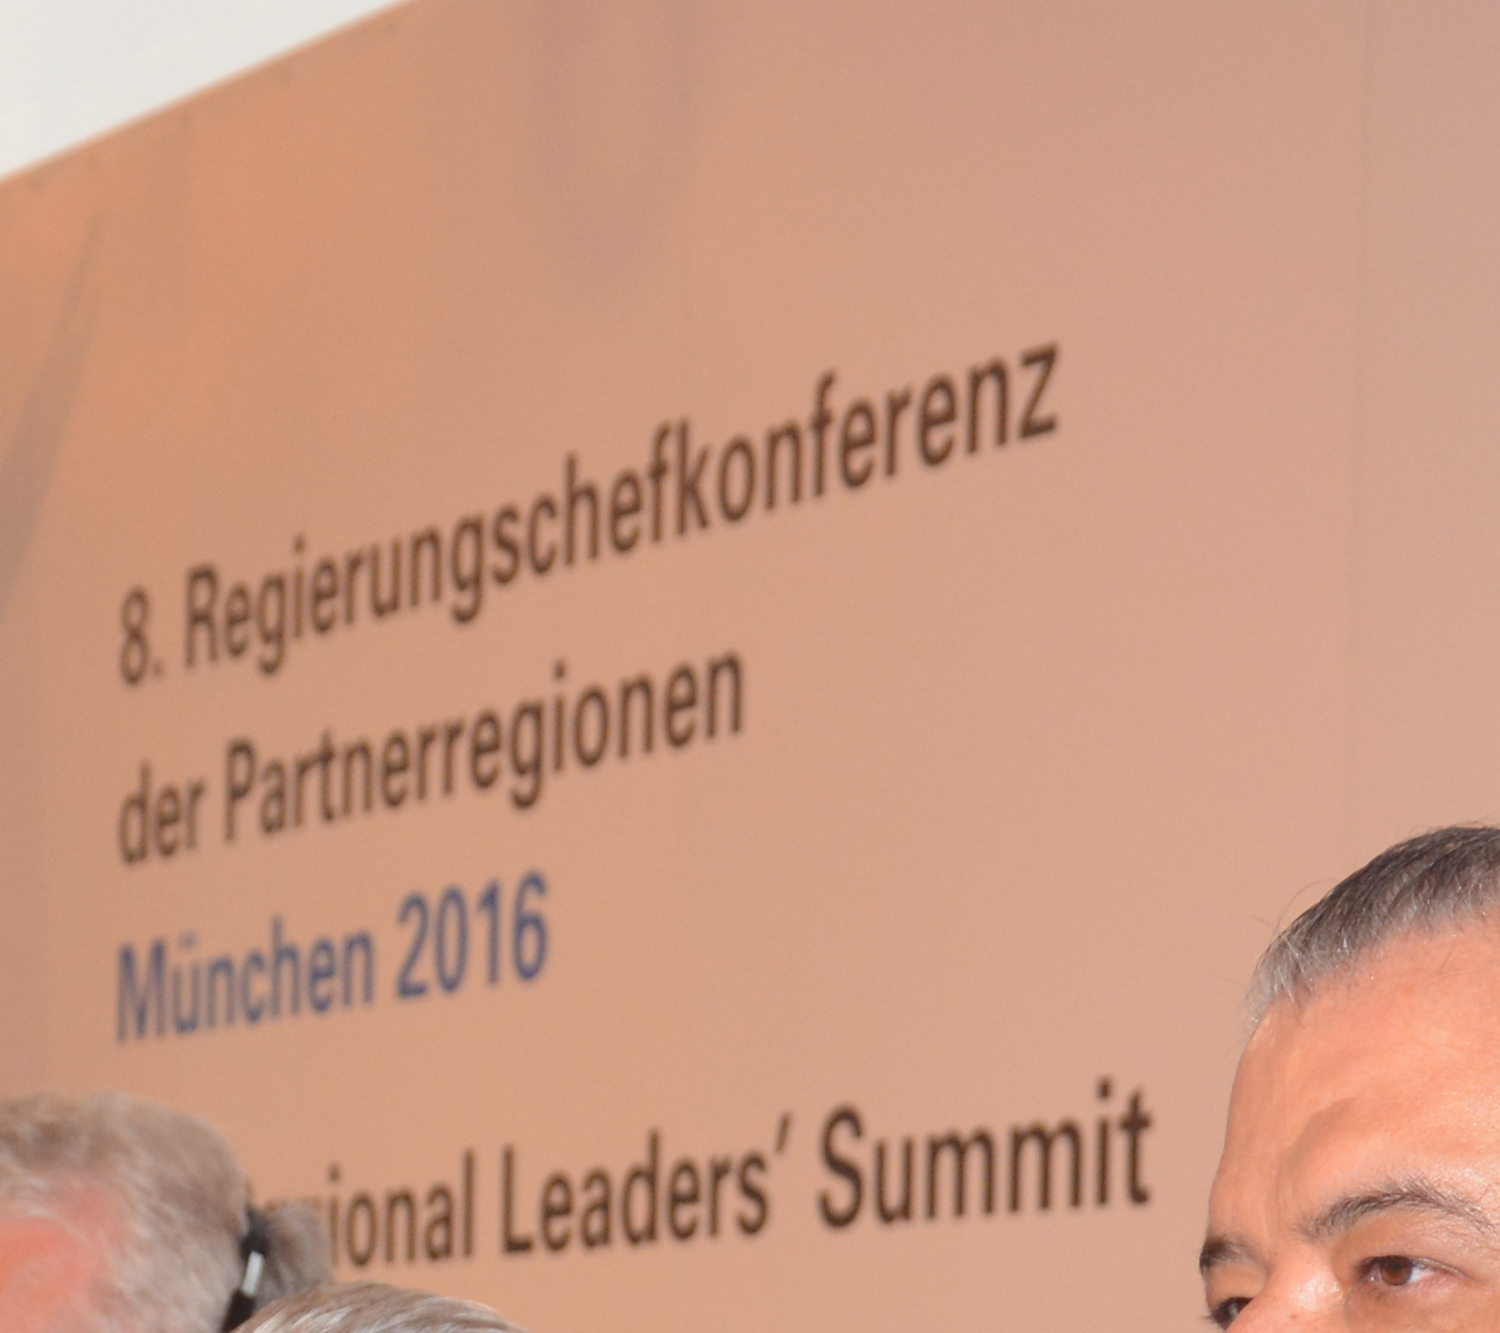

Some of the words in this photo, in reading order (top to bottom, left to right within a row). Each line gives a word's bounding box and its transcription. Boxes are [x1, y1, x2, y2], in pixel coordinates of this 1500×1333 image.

[119, 586, 166, 688] 8.
[184, 342, 1060, 676] Regierungschefkonferenz
[119, 762, 204, 866] der
[225, 650, 746, 845] Partnerregionen
[116, 917, 376, 1045] München
[398, 870, 550, 1004] 2016
[265, 1150, 476, 1267] ional
[816, 1076, 1153, 1231] Summit
